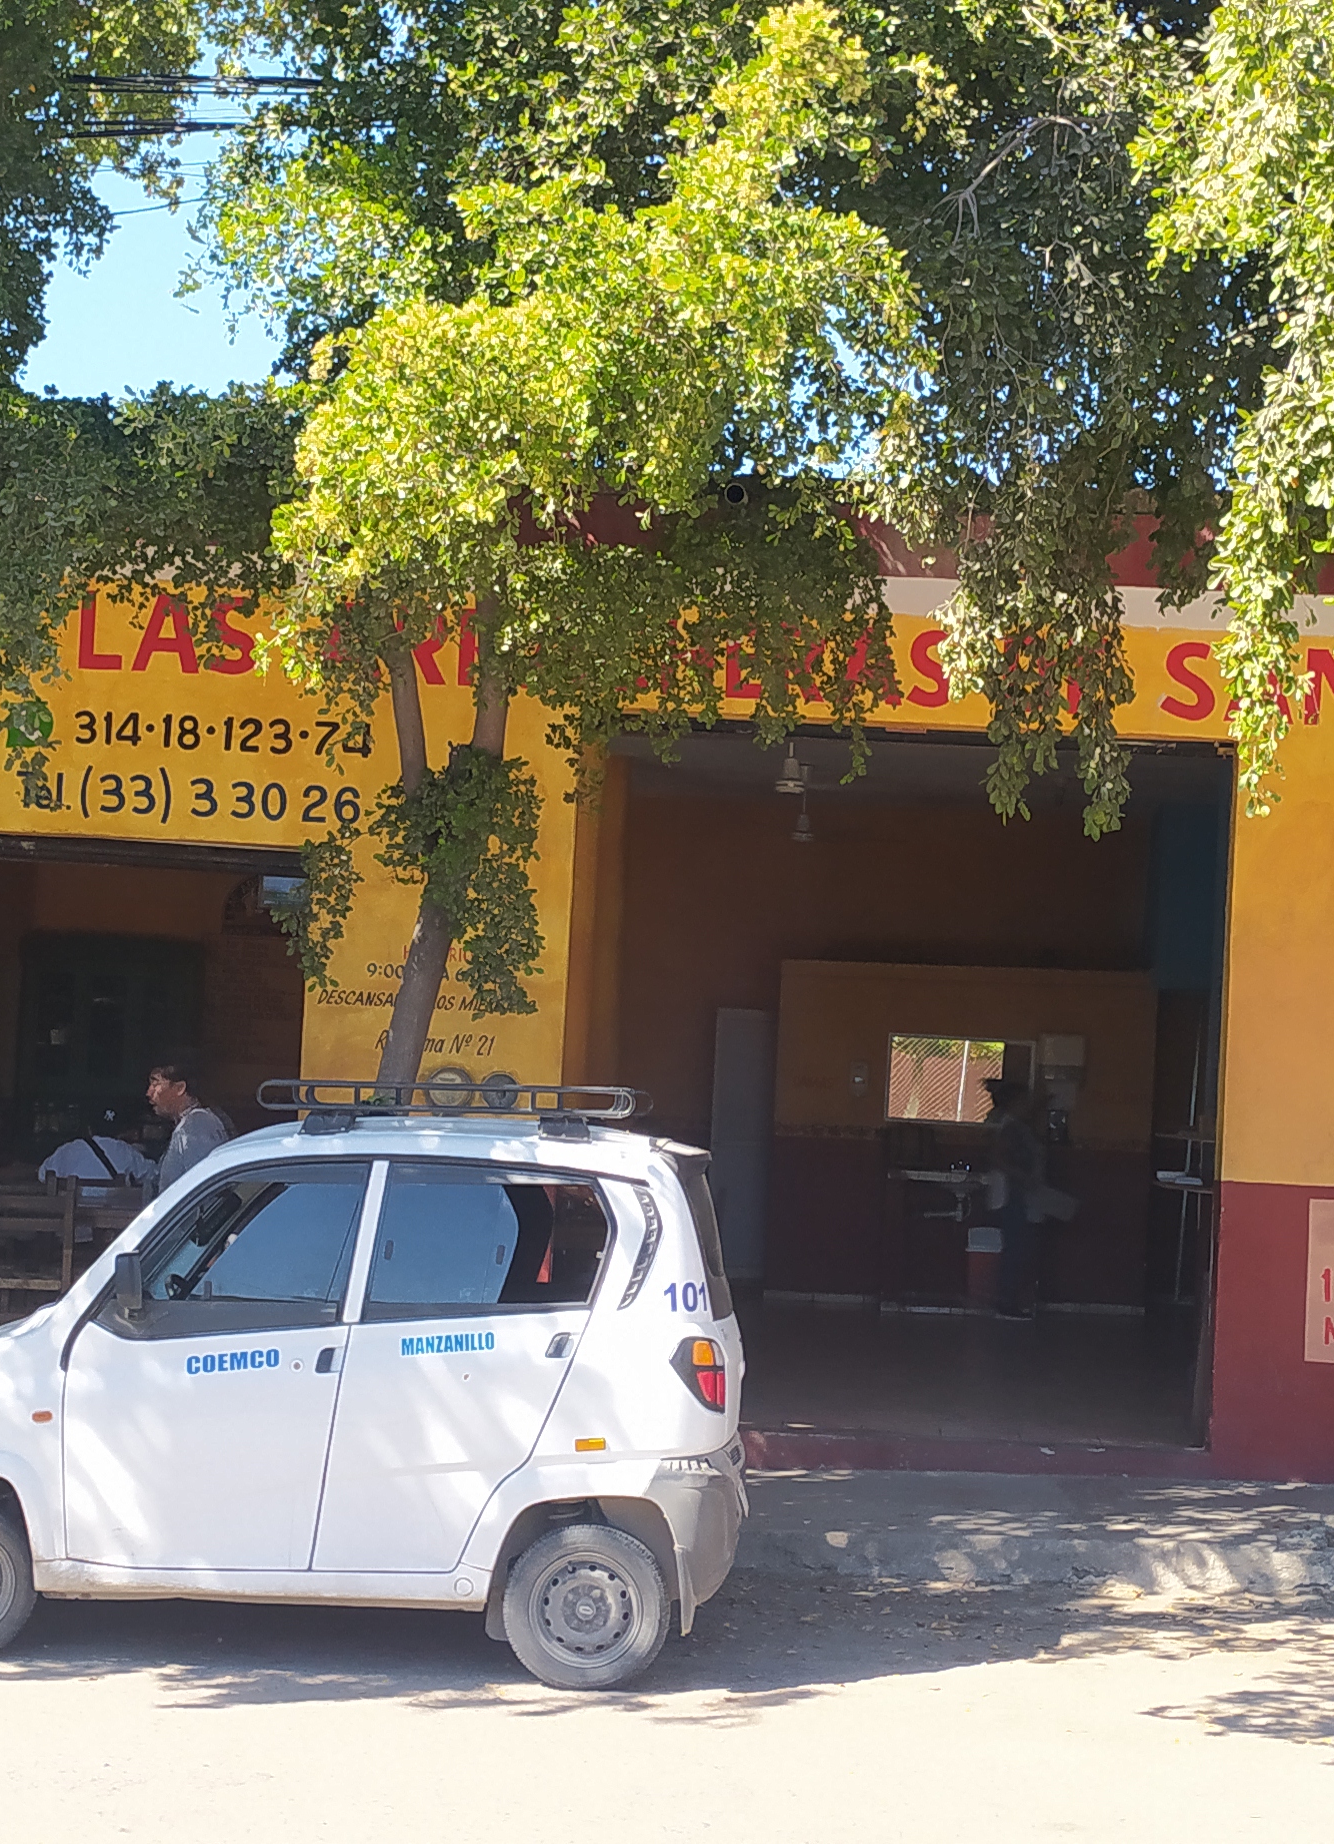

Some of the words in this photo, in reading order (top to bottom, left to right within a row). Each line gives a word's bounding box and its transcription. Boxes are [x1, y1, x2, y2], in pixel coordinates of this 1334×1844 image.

[77, 590, 255, 675] LAS
[80, 764, 172, 825] (33)
[190, 778, 218, 817] 3
[230, 781, 287, 821] 30
[302, 785, 361, 824] 26
[476, 1034, 496, 1057] 21
[663, 1281, 708, 1313] 101
[401, 1331, 496, 1358] MANZANILLO
[185, 1348, 281, 1376] COEMCO
